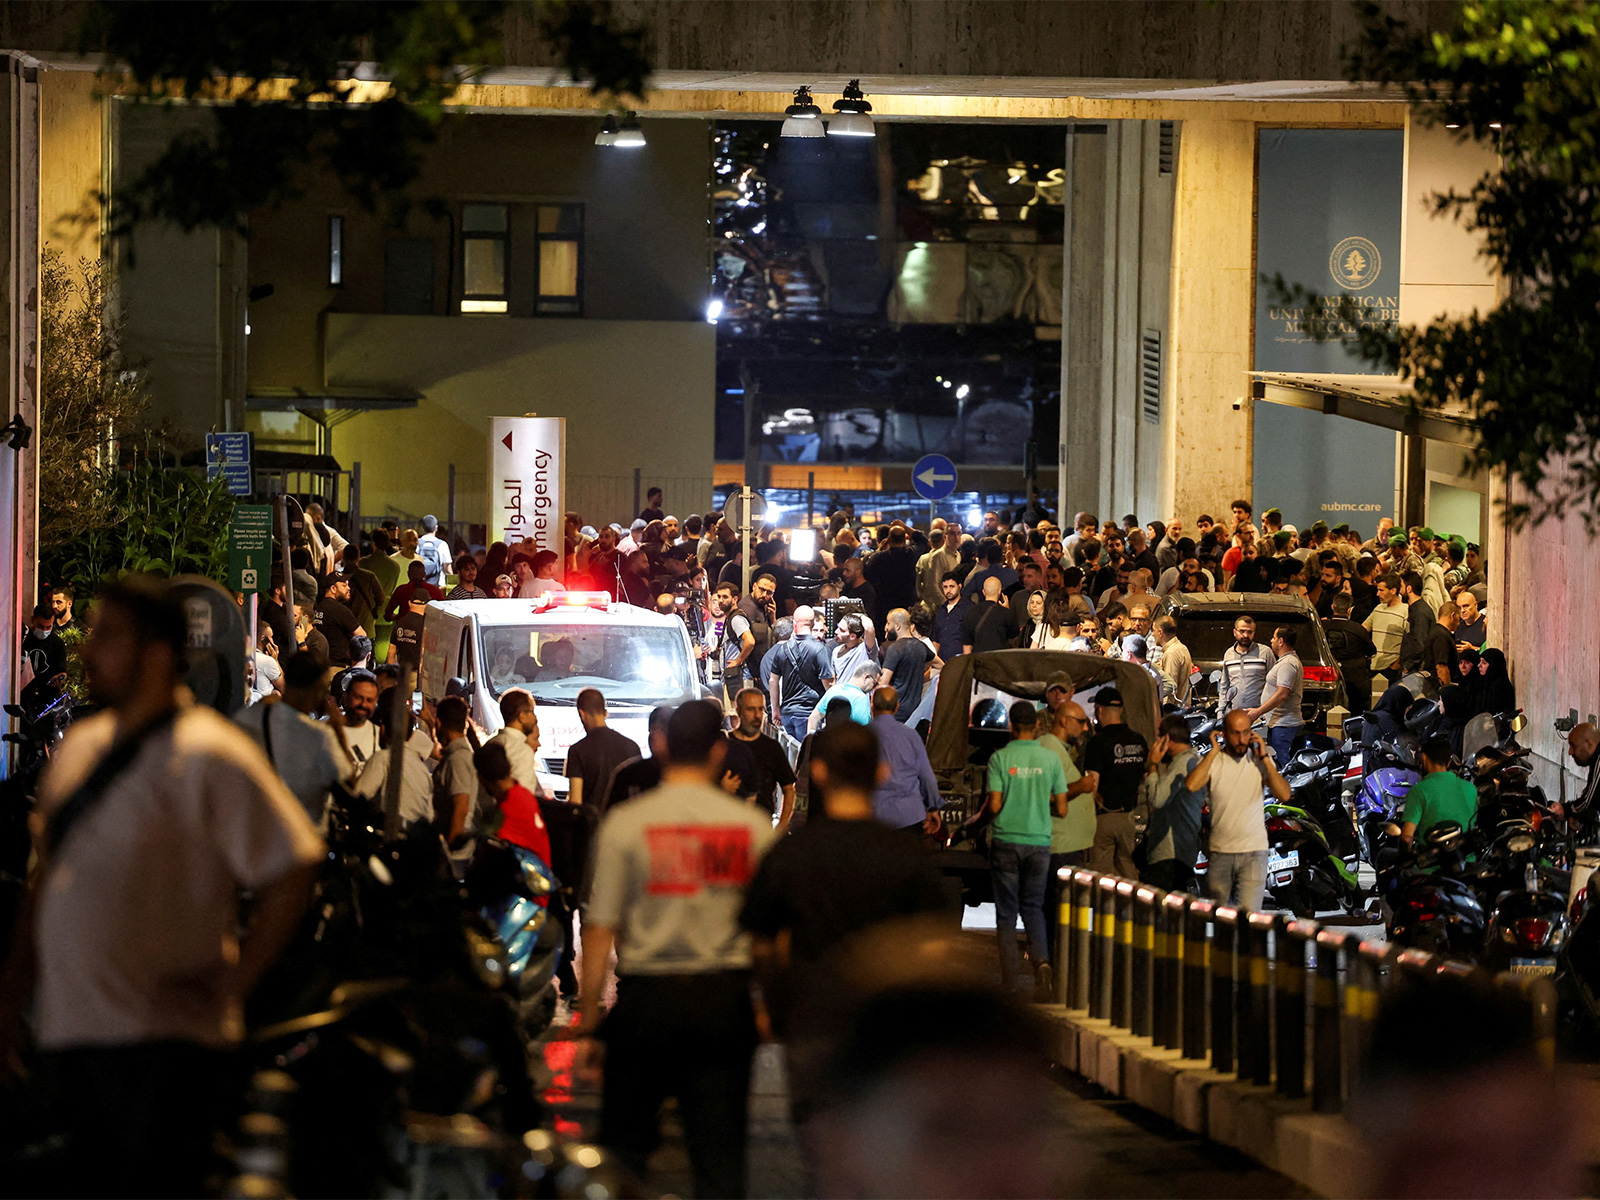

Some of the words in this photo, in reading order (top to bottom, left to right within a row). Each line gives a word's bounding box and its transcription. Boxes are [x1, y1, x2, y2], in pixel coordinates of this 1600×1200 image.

[503, 479, 526, 545] الطوار
[534, 449, 553, 551] mergency
[1320, 501, 1382, 511] aubmc.care
